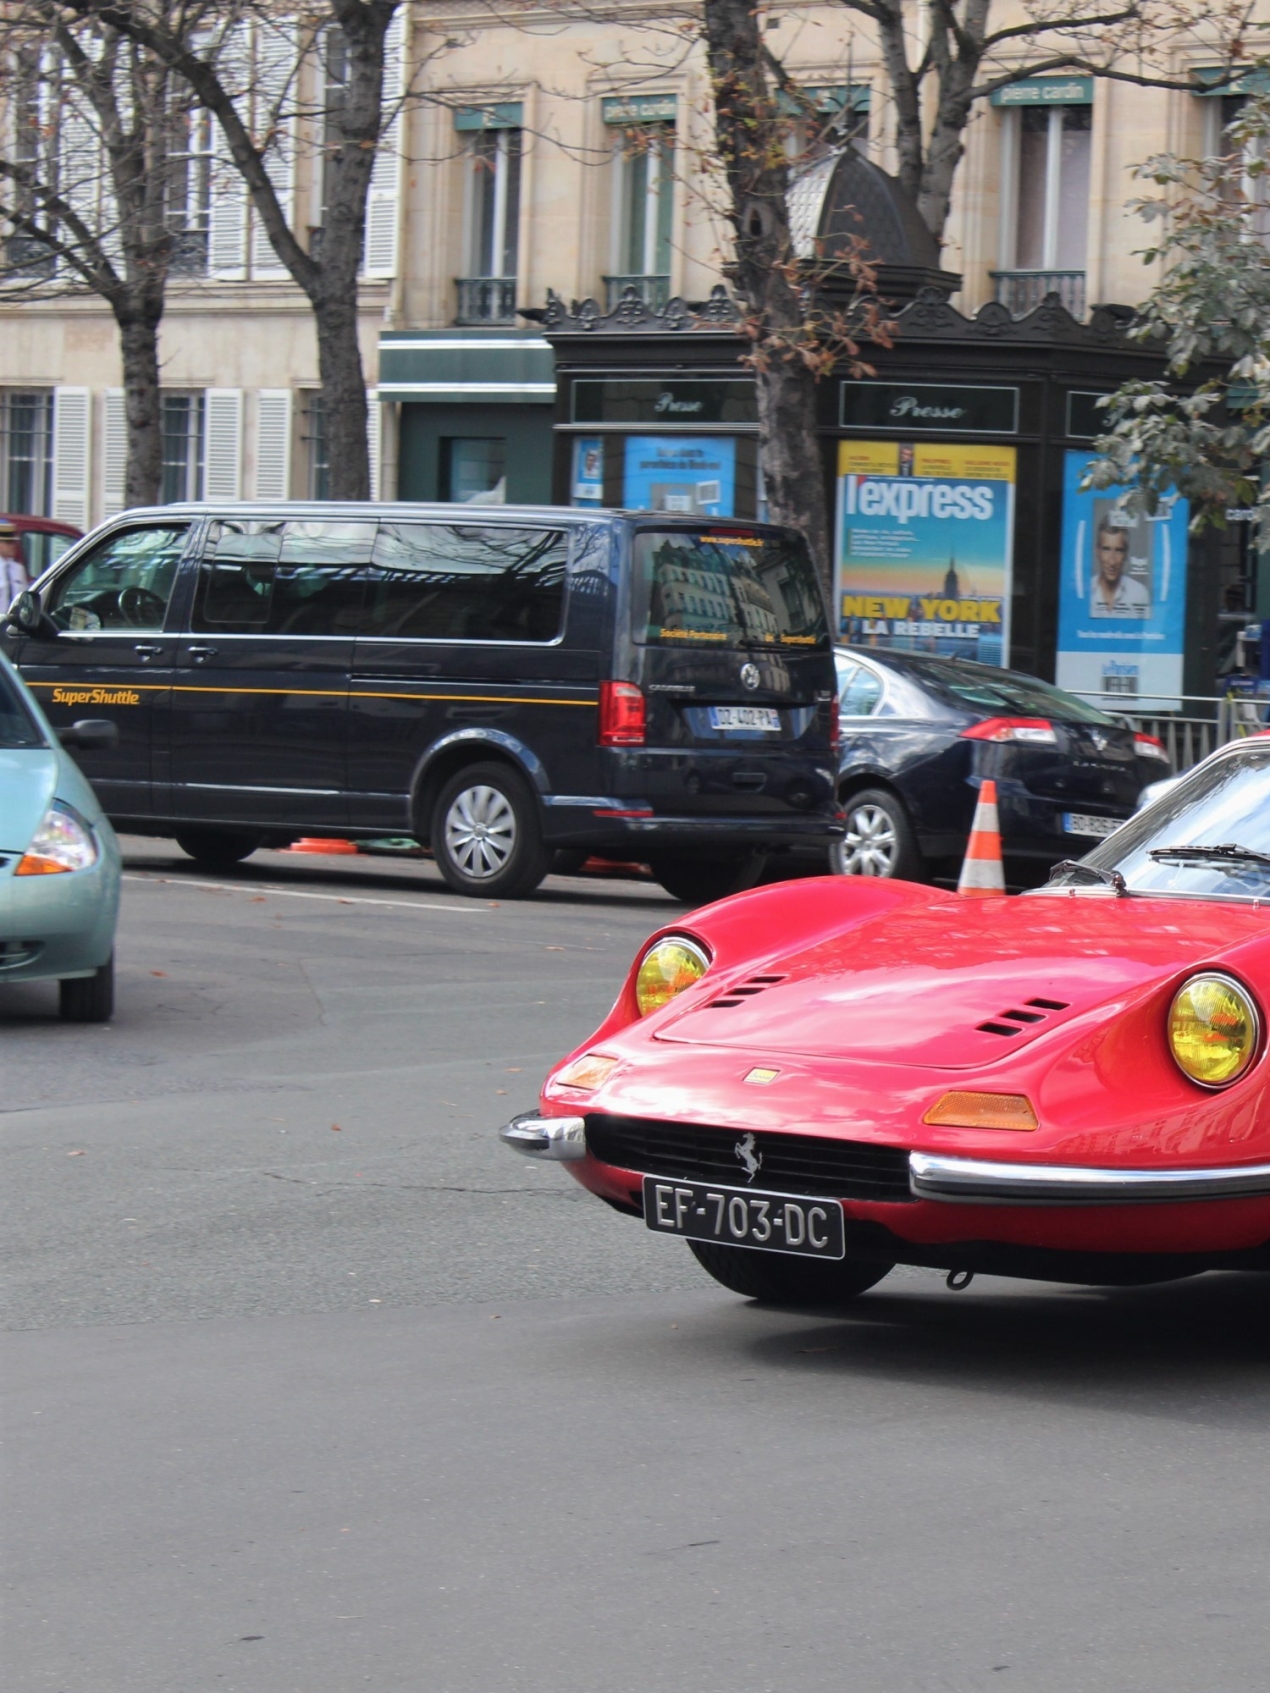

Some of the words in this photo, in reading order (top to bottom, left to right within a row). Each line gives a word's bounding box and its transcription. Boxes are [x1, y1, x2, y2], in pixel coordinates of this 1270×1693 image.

[1001, 84, 1039, 104] pierre
[1042, 82, 1084, 99] cardin
[654, 393, 703, 414] Presse
[889, 396, 967, 419] Presse
[842, 595, 911, 620] NEW
[919, 597, 1002, 623] YORK
[862, 620, 889, 636] LA
[893, 621, 980, 639] REBELLE
[52, 688, 140, 707] SuperShuttle
[655, 1184, 828, 1248] EF-703-DC
